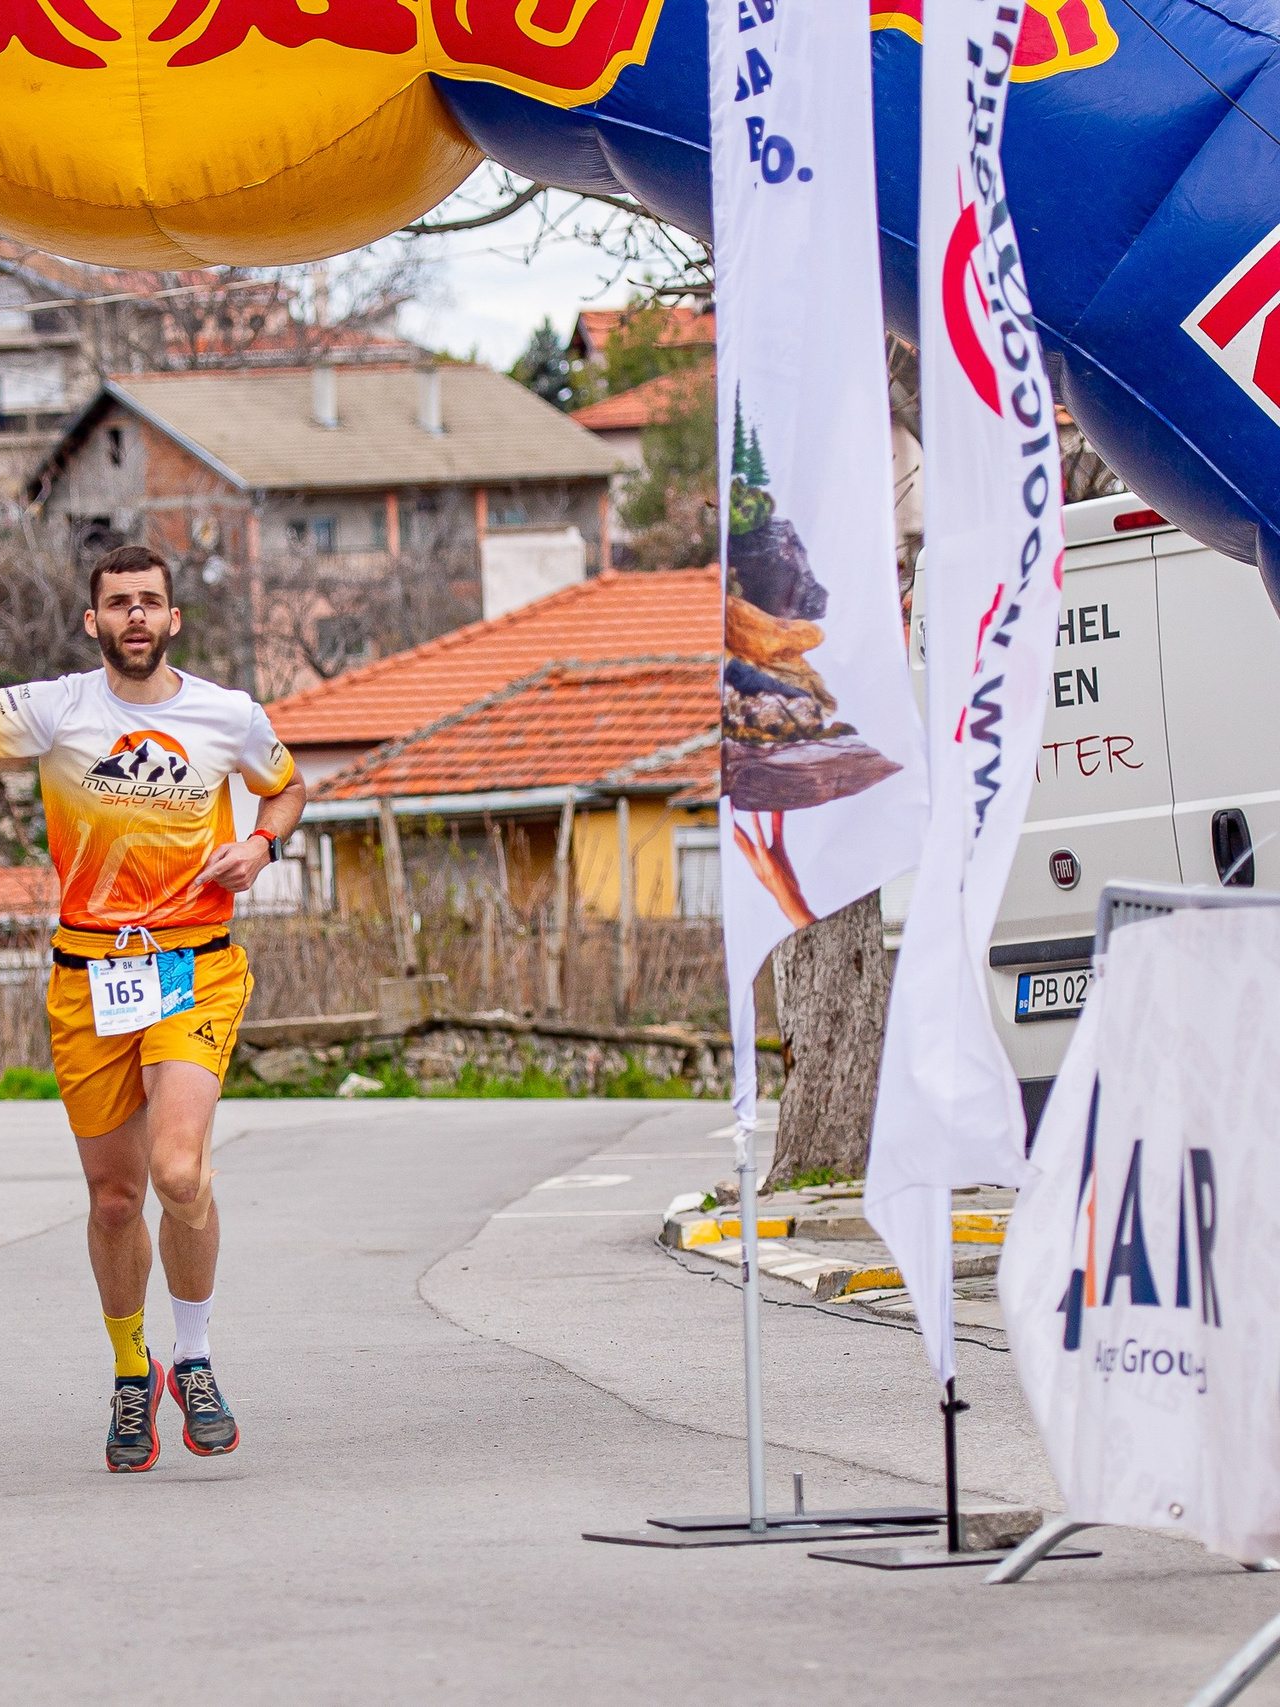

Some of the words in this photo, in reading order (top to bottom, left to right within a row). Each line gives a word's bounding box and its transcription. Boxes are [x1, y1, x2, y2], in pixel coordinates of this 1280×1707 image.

[1047, 667, 1099, 708] EN
[100, 793, 146, 807] SKY
[1055, 858, 1073, 879] FIAT
[122, 961, 133, 970] 8K
[105, 979, 144, 1005] 165
[1032, 977, 1058, 1008] PB
[1064, 973, 1093, 1004] 02
